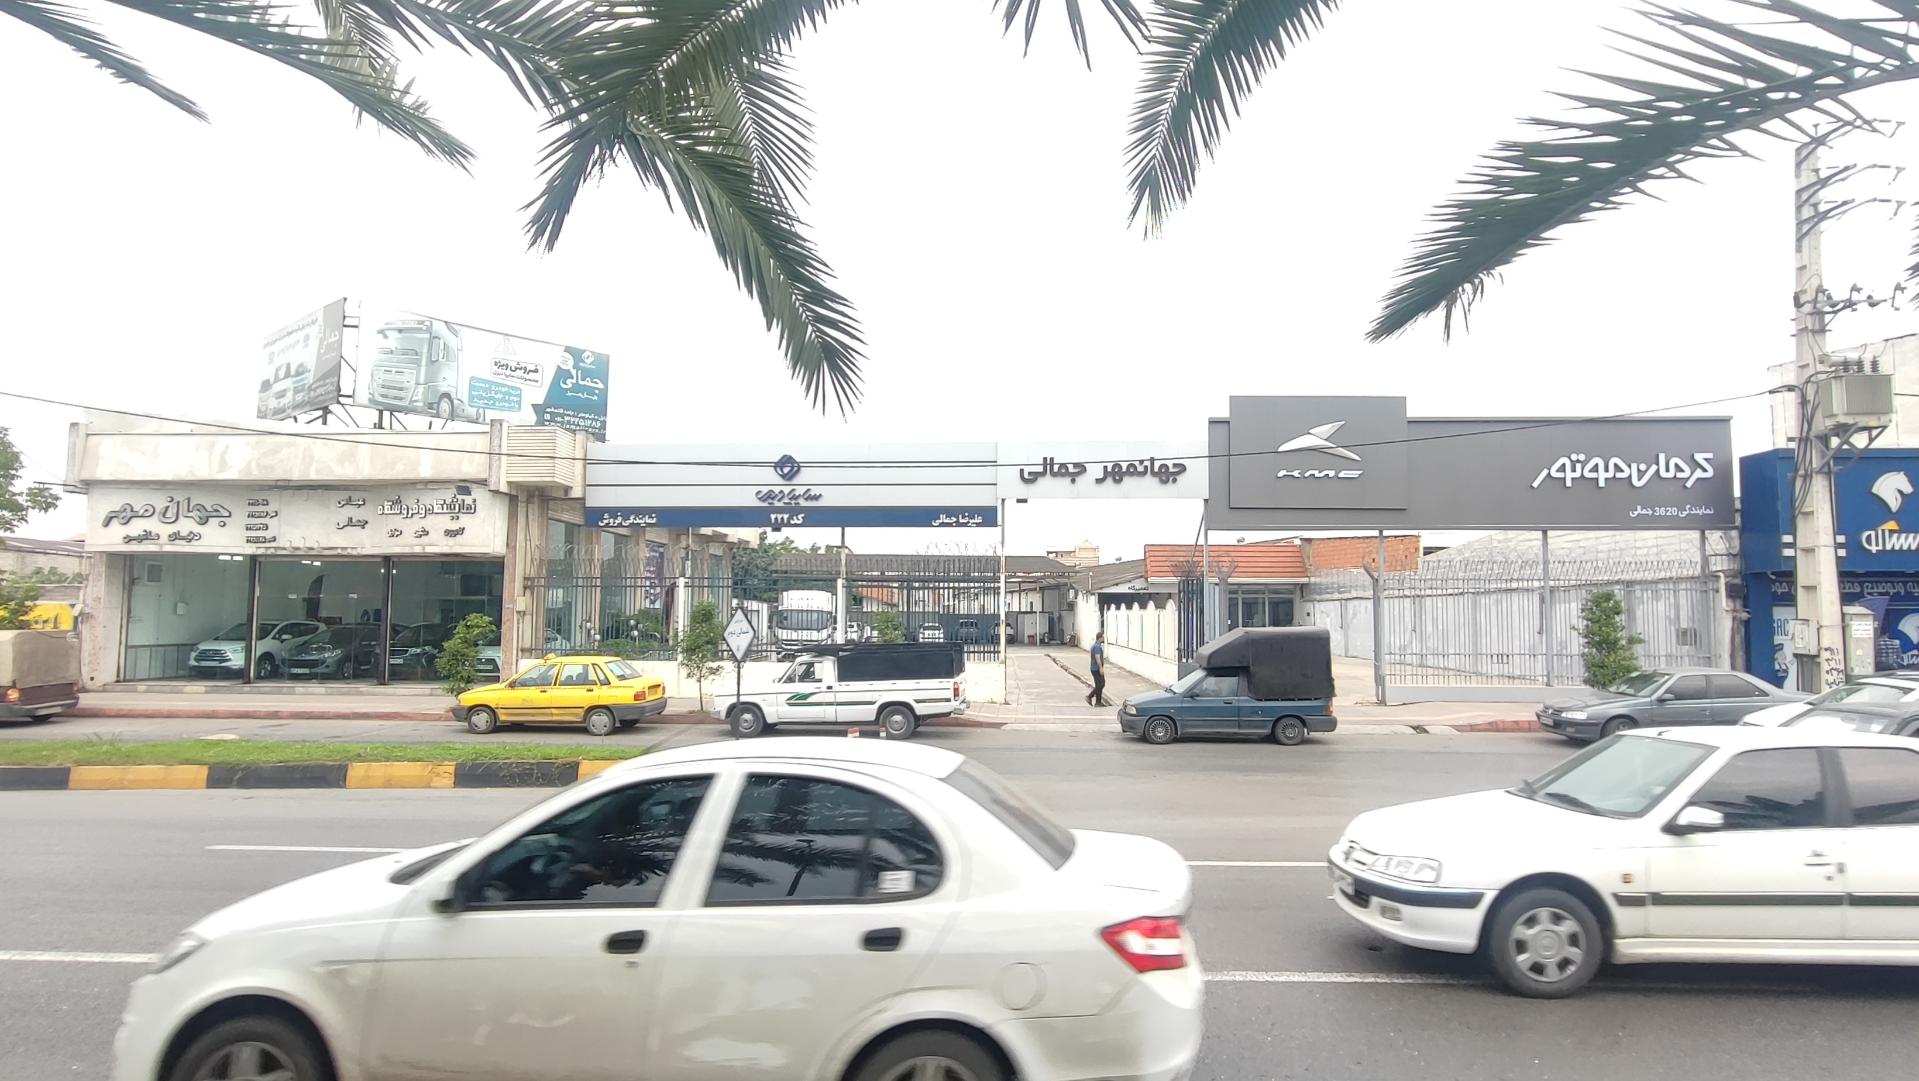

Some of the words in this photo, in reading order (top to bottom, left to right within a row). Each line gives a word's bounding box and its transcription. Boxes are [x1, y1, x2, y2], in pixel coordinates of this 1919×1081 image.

[494, 360, 509, 370] ویژه
[509, 361, 539, 375] فروش
[560, 368, 605, 393] جمالی
[1019, 457, 1087, 485] جمالی
[1530, 452, 1631, 488] موتور
[1630, 452, 1714, 488] کرمان
[336, 496, 366, 508] عباس
[102, 503, 156, 527] مهر
[158, 496, 232, 527] جهان
[1629, 505, 1653, 517] جمالی
[1654, 507, 1678, 516] 3620
[1679, 504, 1714, 517] نمایندگی
[335, 516, 368, 529] جمالی
[598, 512, 623, 527] فروش
[622, 513, 657, 527] نمایندگی
[790, 513, 805, 525] کد
[931, 513, 958, 527] جمالی
[958, 512, 983, 527] علیرضا
